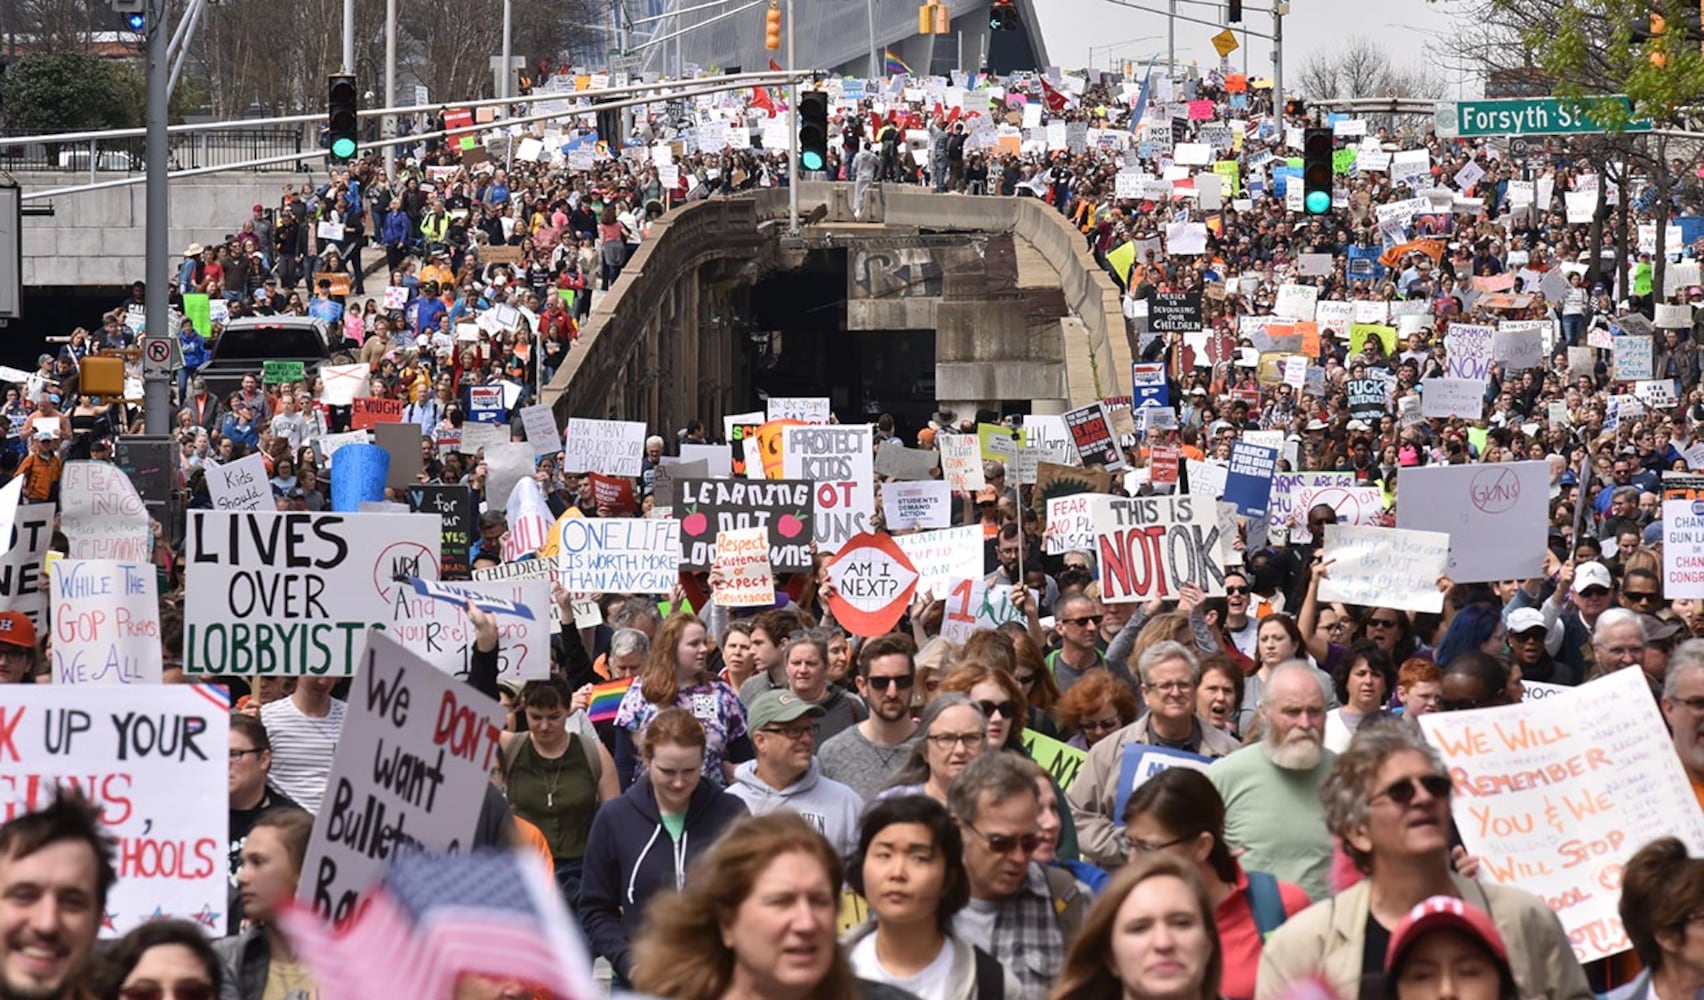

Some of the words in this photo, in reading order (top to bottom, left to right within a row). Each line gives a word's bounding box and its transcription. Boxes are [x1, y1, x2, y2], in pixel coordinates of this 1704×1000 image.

[1462, 104, 1549, 132] Forsyth
[1558, 104, 1582, 127] St
[1151, 127, 1170, 135] NOT
[1153, 319, 1201, 330] CHILDREN
[1450, 326, 1492, 339] COMMON
[1447, 357, 1492, 380] NOW
[1347, 380, 1385, 395] FUCK
[790, 429, 868, 454] PROTECT
[1233, 443, 1270, 459] MARCH
[802, 456, 853, 481] KIDS
[1229, 463, 1259, 477] LIVES
[1231, 453, 1252, 467] FOR
[1252, 456, 1274, 470] OUR
[224, 466, 254, 490] Kids
[91, 492, 144, 516] NO
[217, 488, 265, 511] Should
[432, 492, 459, 512] for
[682, 480, 810, 506] LEARNING
[817, 482, 858, 508] OT
[898, 497, 939, 505] STUDENTS
[1473, 482, 1518, 503] GUNS
[900, 510, 927, 518] ACTION
[1053, 499, 1088, 516] FEAR
[1110, 500, 1160, 526] THIS
[1171, 498, 1194, 523] IS
[441, 515, 461, 527] ur
[814, 512, 866, 544] UNS
[1049, 519, 1071, 535] NO
[1076, 516, 1095, 533] PL
[193, 512, 349, 570] LIVES
[562, 520, 623, 553] ONE
[626, 521, 680, 552] LIFE
[717, 532, 768, 555] Respect
[948, 527, 975, 541] FIX
[1049, 535, 1065, 552] IN
[1068, 534, 1095, 549] SCH
[1669, 531, 1693, 544] GUN
[475, 557, 560, 581] CHILDREN
[566, 552, 583, 570] IS
[587, 553, 639, 571] WORTH
[641, 553, 679, 571] MORE
[843, 561, 872, 577] AM
[879, 562, 891, 577] I
[920, 563, 951, 577] CAN
[1098, 526, 1168, 599] NOT
[1167, 524, 1226, 594] OK
[51, 562, 113, 599] WHILE
[117, 564, 147, 596] THE
[433, 582, 485, 601] LIVES
[560, 570, 607, 590] THAN
[609, 571, 641, 590] ANY
[641, 571, 676, 590] GUN
[841, 578, 898, 597] NEXT?
[228, 570, 330, 619] OVER
[393, 586, 436, 622] And
[714, 592, 773, 605] Resistance
[947, 578, 976, 624] 1
[57, 602, 106, 644] GOP
[186, 622, 387, 675] LOBBYIST
[393, 620, 480, 654] youRsel
[55, 649, 90, 686] WE
[91, 642, 144, 684] ALL
[366, 647, 411, 728] We
[433, 689, 502, 773] DON'T
[44, 708, 92, 755] UP
[110, 711, 210, 763] YOUR
[1432, 725, 1495, 758] WE
[1494, 719, 1572, 751] WILL
[373, 739, 445, 814] want
[1450, 747, 1614, 800] REMEMBER
[1467, 805, 1534, 838] YOU
[1562, 788, 1617, 823] WE
[112, 837, 217, 880] HOOLS
[1480, 854, 1553, 884] WILL
[1557, 829, 1625, 869] STOP
[1540, 886, 1593, 912] OOL
